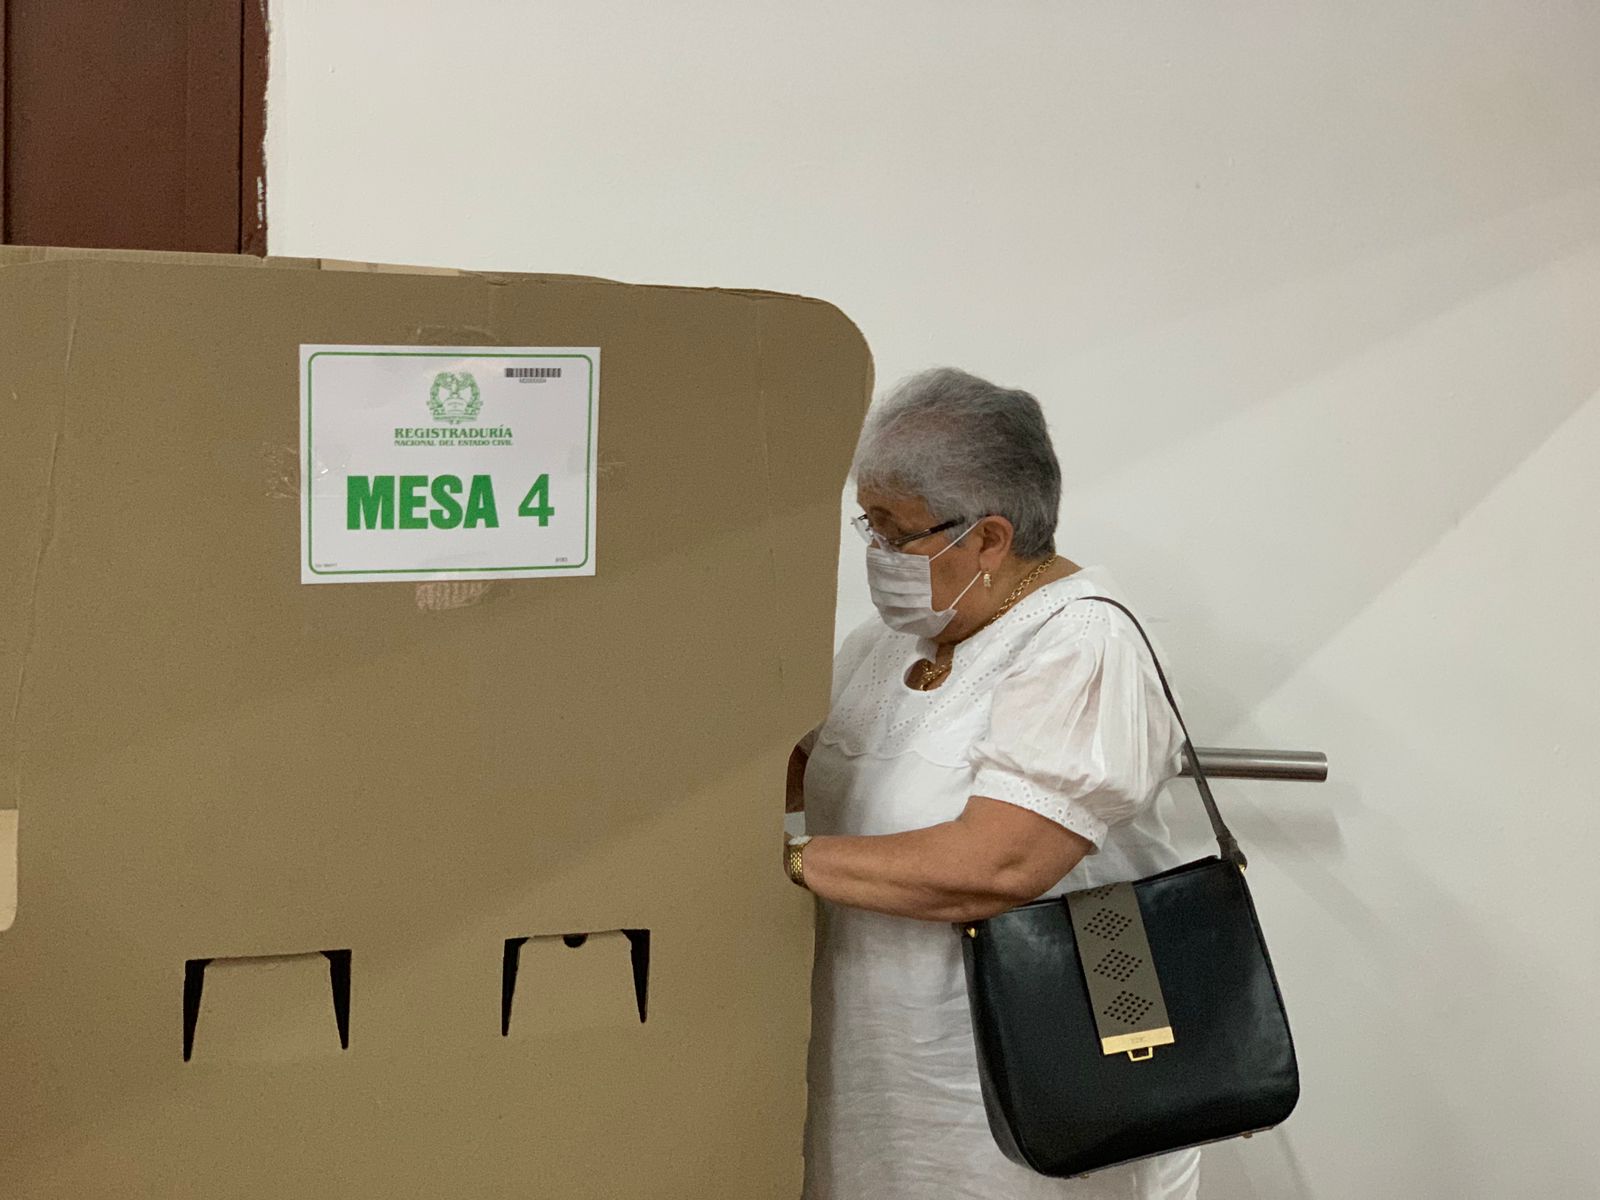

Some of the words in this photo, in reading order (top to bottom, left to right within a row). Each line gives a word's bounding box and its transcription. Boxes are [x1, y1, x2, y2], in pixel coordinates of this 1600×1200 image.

[394, 425, 513, 439] REGISTRADURÍA
[394, 439, 437, 447] NACIONAL
[439, 439, 455, 447] DEL
[457, 439, 490, 447] ESTADO
[492, 439, 513, 447] CIVIL
[347, 474, 499, 530] MESA
[518, 473, 555, 527] 4
